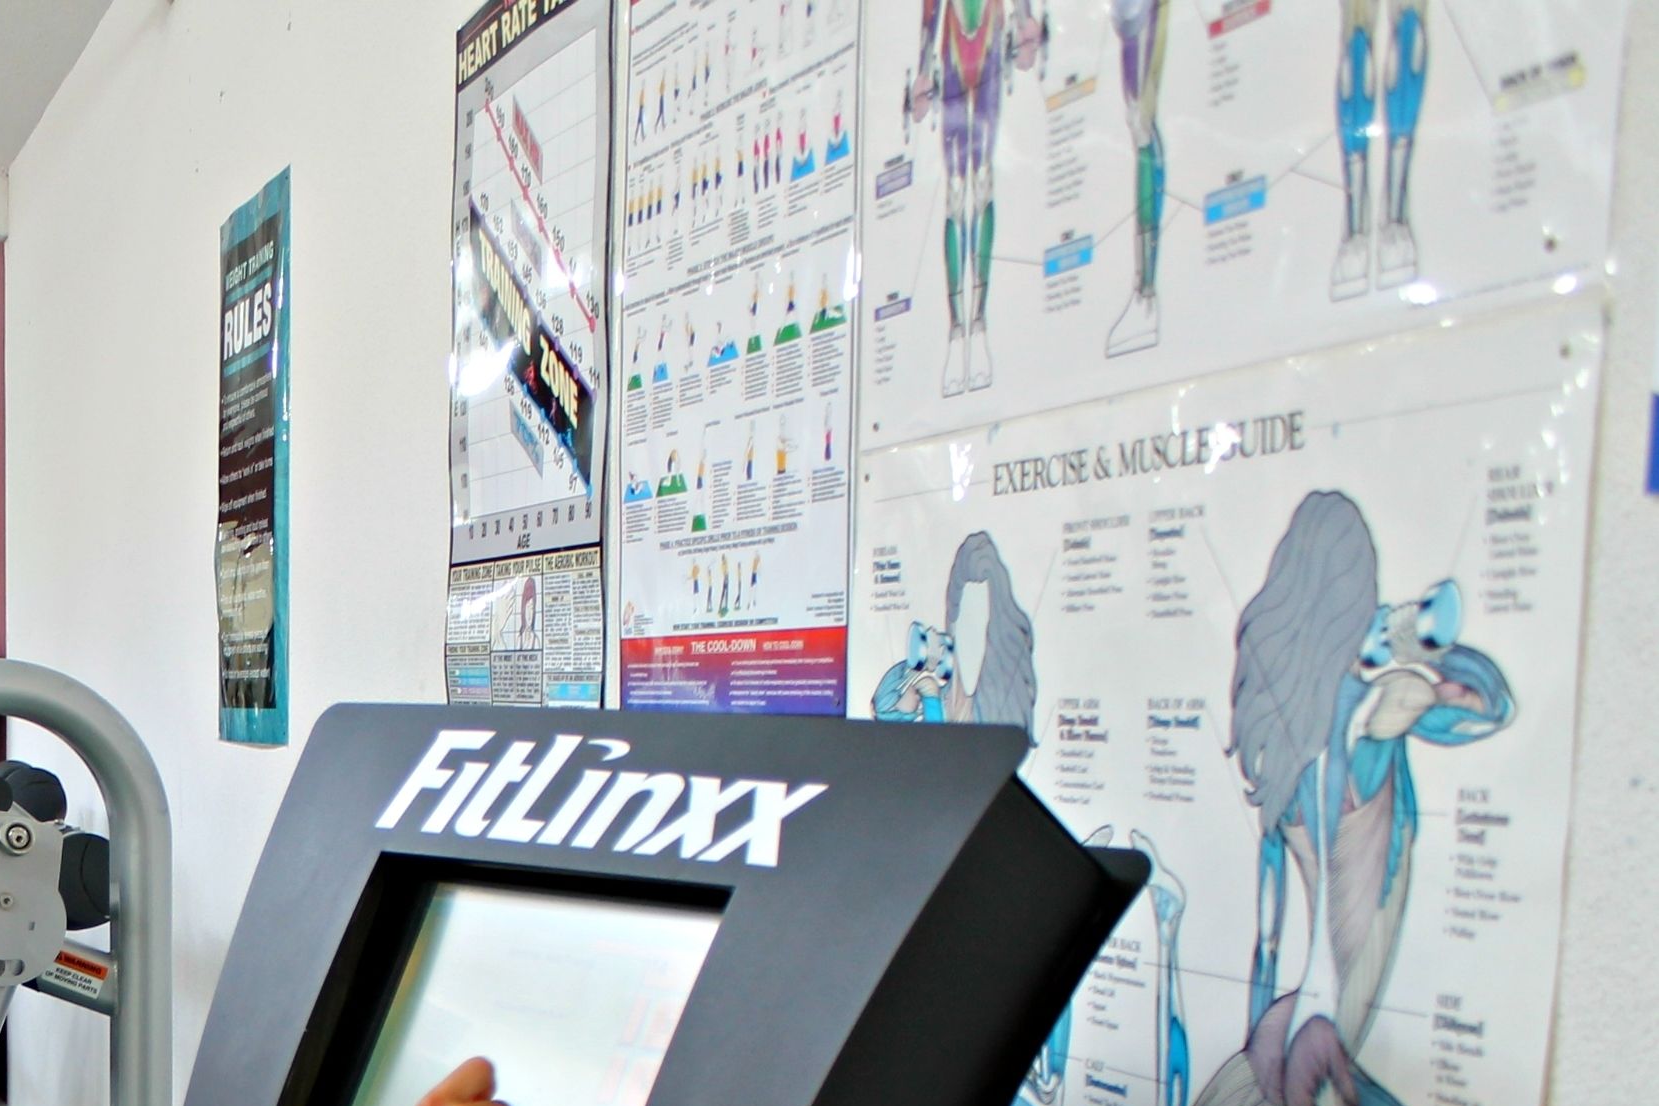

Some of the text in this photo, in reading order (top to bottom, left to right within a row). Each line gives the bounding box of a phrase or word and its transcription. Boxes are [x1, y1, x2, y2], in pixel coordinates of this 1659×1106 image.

[458, 0, 538, 86] HEART RATE
[248, 240, 274, 276] TRAINING
[586, 291, 600, 320] 130
[223, 282, 272, 361] RULES
[479, 229, 531, 356] TRAINING
[539, 333, 579, 430] ZONE
[551, 313, 564, 336] 128
[569, 341, 583, 364] 119
[589, 366, 600, 389] 111
[538, 423, 550, 446] 112
[992, 447, 1089, 497] EXERCISE
[1092, 445, 1112, 481] &
[1117, 425, 1210, 478] MUSCLE
[517, 533, 531, 550] AGE
[691, 641, 706, 655] THE
[374, 729, 830, 868] FitLinxx
[56, 967, 93, 985] KEEP CLEAR
[64, 955, 102, 975] WARNING
[54, 973, 78, 986] MOVING
[78, 982, 98, 994] PARTS
